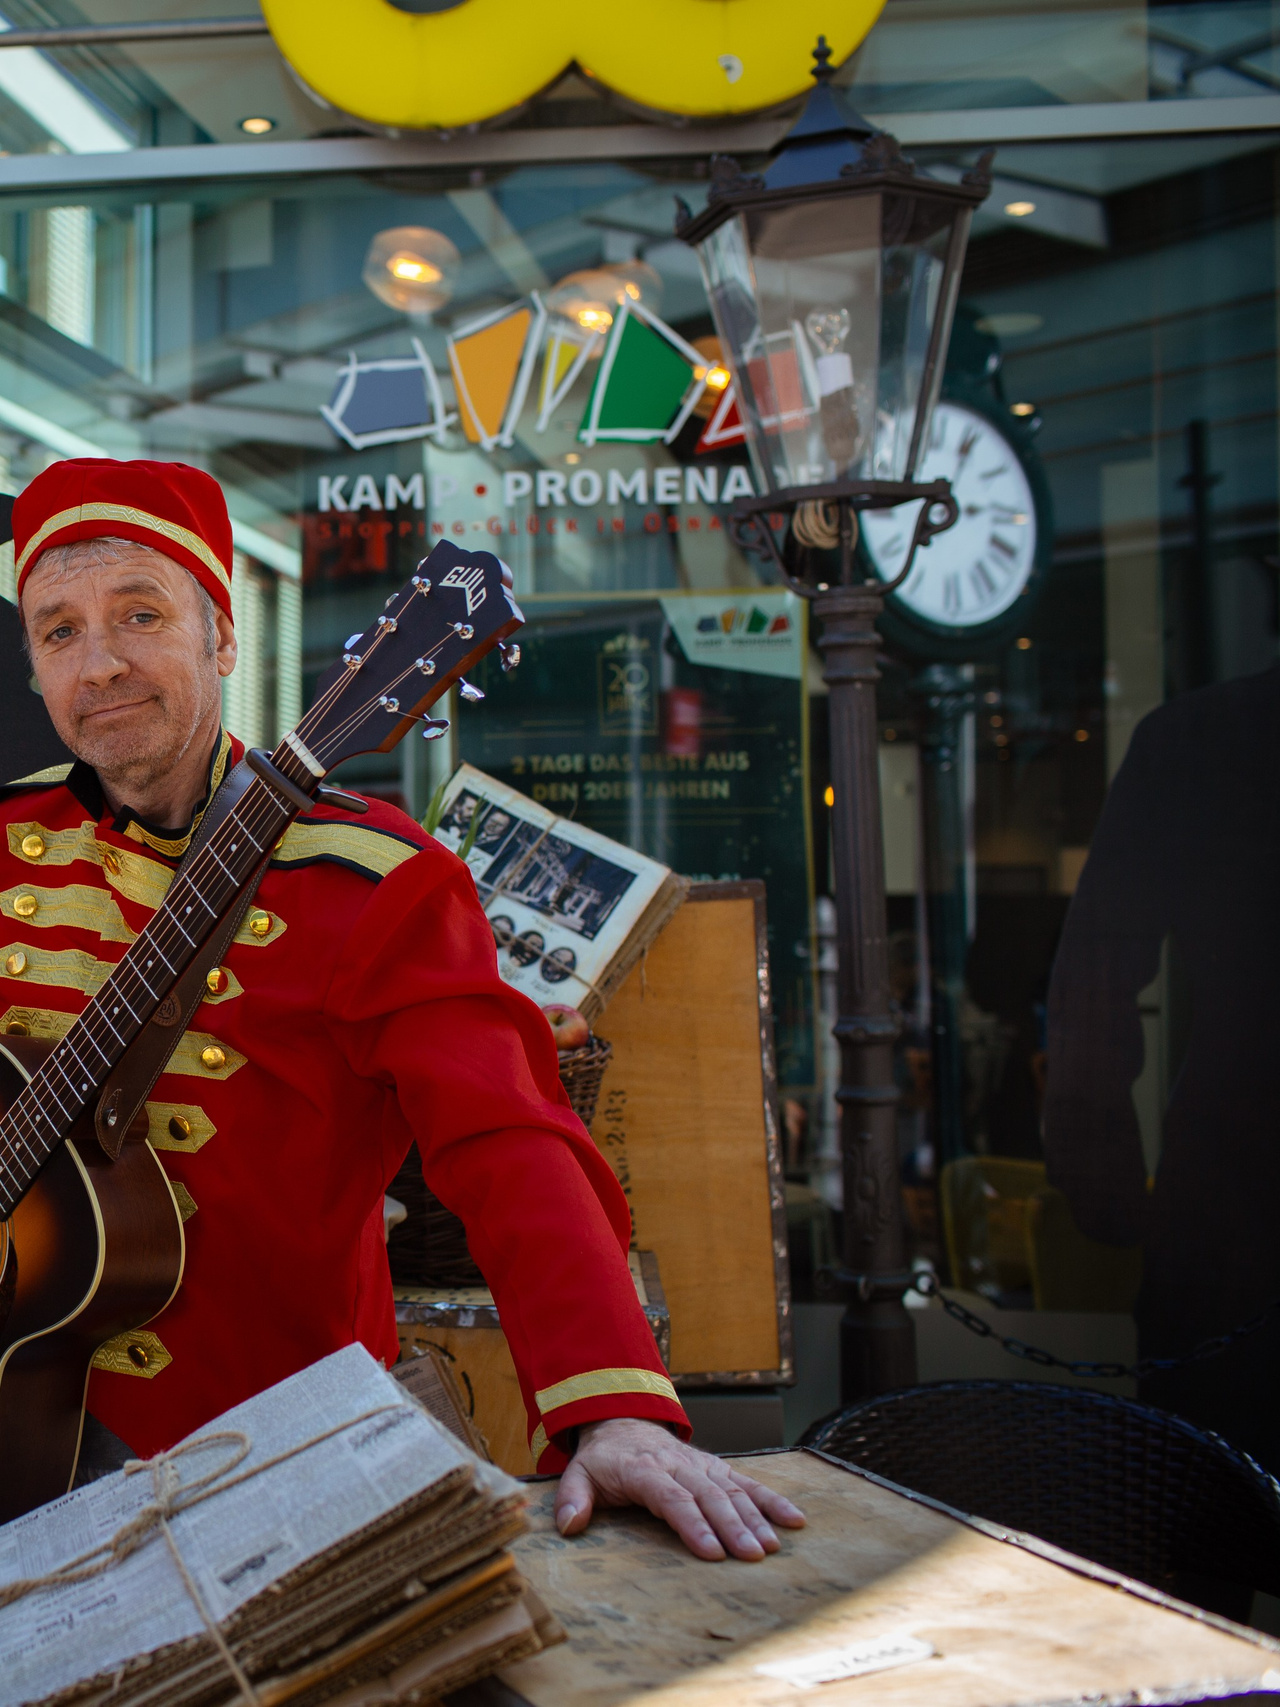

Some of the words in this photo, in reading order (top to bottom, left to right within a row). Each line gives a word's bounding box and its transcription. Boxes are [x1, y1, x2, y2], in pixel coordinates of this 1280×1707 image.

[317, 472, 458, 512] KAMP
[438, 566, 487, 617] GUILD
[608, 661, 650, 692] 20
[530, 753, 585, 774] TAGE
[589, 753, 635, 773] DAS
[704, 751, 750, 772] AUS
[532, 782, 579, 801] DEN
[645, 779, 731, 801] JAHREN
